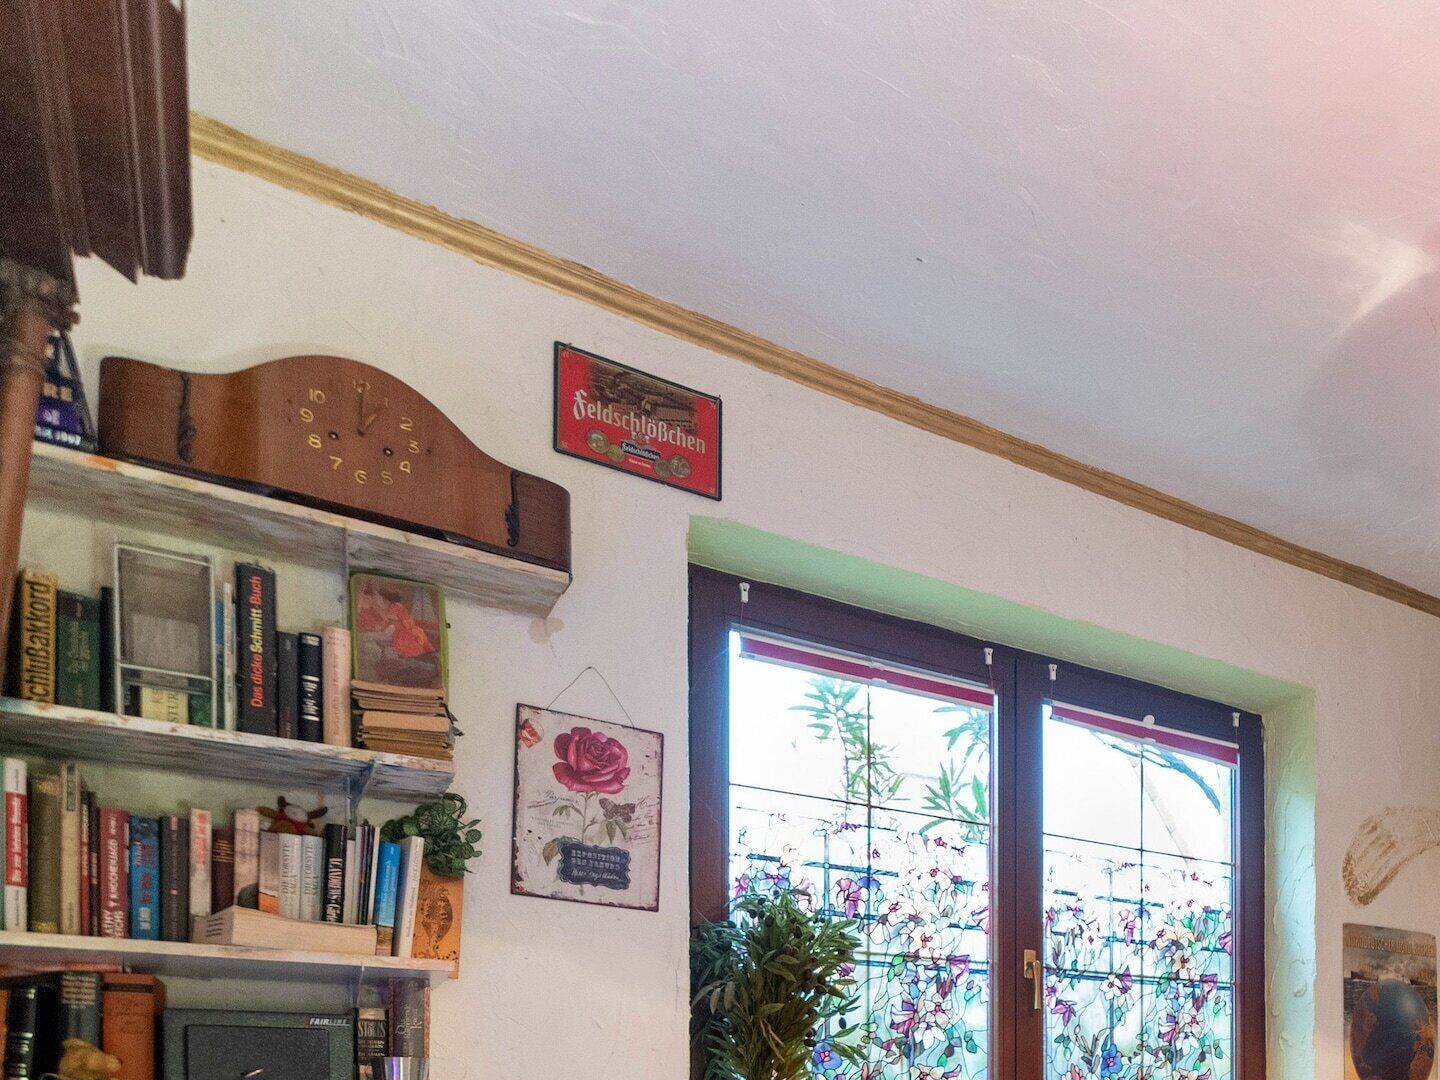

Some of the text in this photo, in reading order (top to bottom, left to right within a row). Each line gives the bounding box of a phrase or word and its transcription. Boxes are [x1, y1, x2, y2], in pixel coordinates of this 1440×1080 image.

[309, 388, 325, 404] 10
[299, 407, 314, 422] 9
[573, 389, 706, 454] Feldschlößchen
[400, 416, 413, 431] 2
[308, 433, 322, 449] 8
[408, 439, 420, 454] 3
[329, 455, 343, 471] 7
[354, 469, 368, 485] 6
[381, 470, 394, 485] 5
[25, 580, 51, 703] chlußakkord
[250, 653, 264, 685] dicke
[250, 688, 265, 709] Das
[310, 1018, 347, 1026] FAIRLINE
